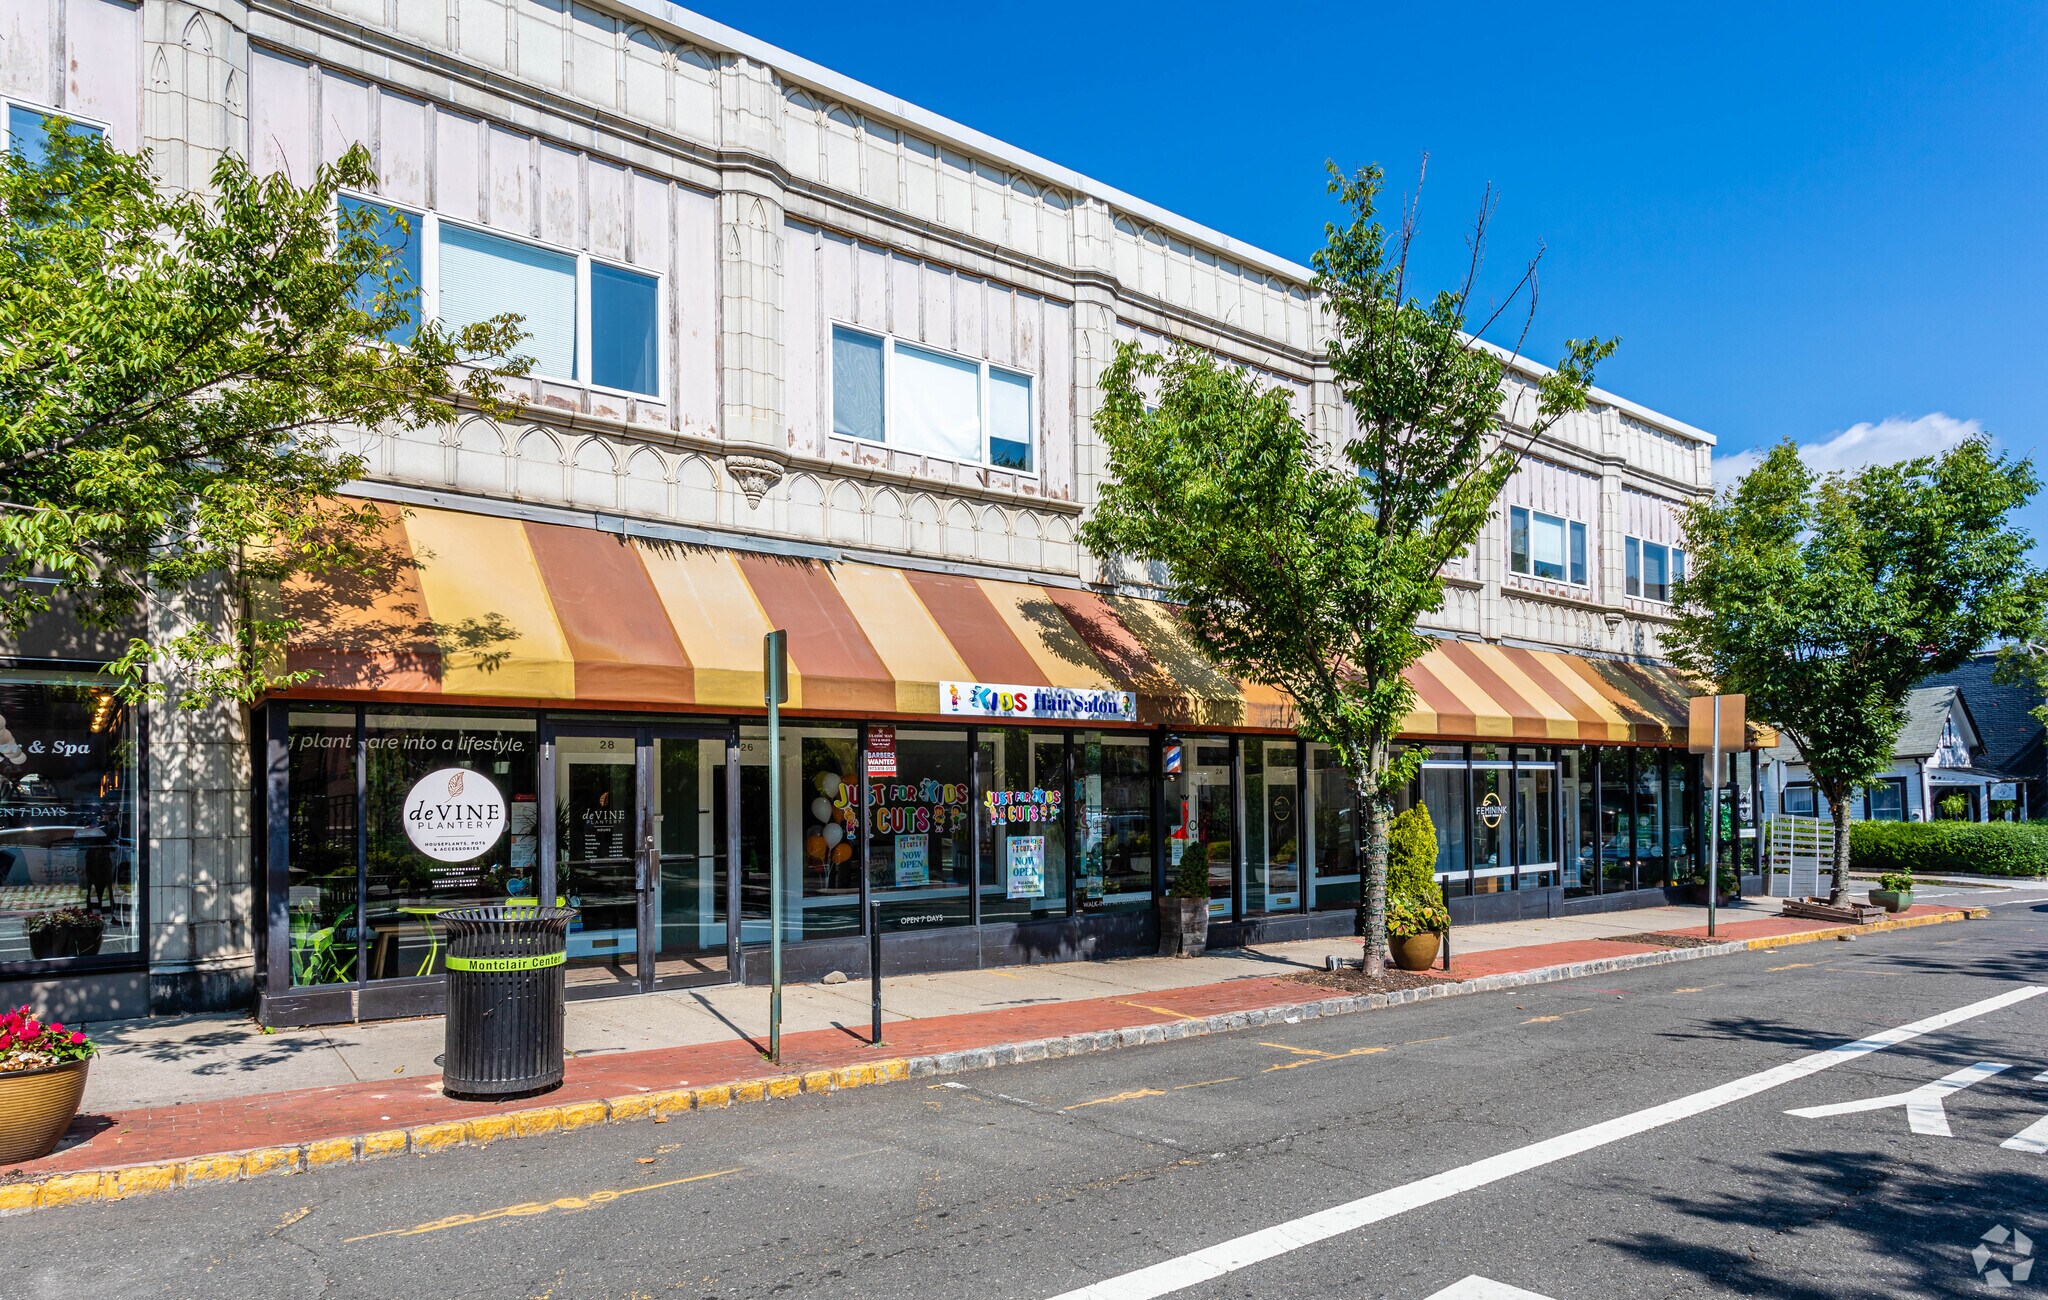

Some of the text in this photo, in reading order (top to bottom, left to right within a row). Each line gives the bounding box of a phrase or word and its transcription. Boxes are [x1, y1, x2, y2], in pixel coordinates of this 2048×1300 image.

[970, 686, 1118, 713] KIDS Hair Salon
[28, 740, 46, 754] &
[51, 740, 91, 757] Spa
[300, 732, 352, 752] plant
[365, 737, 399, 749] are
[403, 734, 437, 750] into
[441, 739, 454, 750] a
[458, 736, 525, 755] lifestyle.
[599, 740, 615, 750] 28
[740, 743, 754, 752] 26
[889, 784, 917, 802] FOR
[919, 777, 969, 806] KIDS
[984, 787, 1061, 807] JUST FOR KIDS
[19, 808, 27, 818] 7
[31, 807, 67, 817] DAYS
[409, 799, 500, 821] deVINE
[582, 808, 625, 820] deVINE
[1007, 805, 1039, 823] CUTS
[1476, 805, 1508, 815] FEMININK
[418, 821, 493, 830] PLANTERY
[877, 806, 930, 834] CUTS
[902, 850, 922, 859] NOW
[900, 860, 924, 868] OPEN
[1014, 856, 1036, 865] NOW
[1012, 867, 1038, 876] OPEN
[900, 916, 919, 924] OPEN
[926, 914, 944, 923] DAYS
[469, 955, 561, 970] Montclair Center
